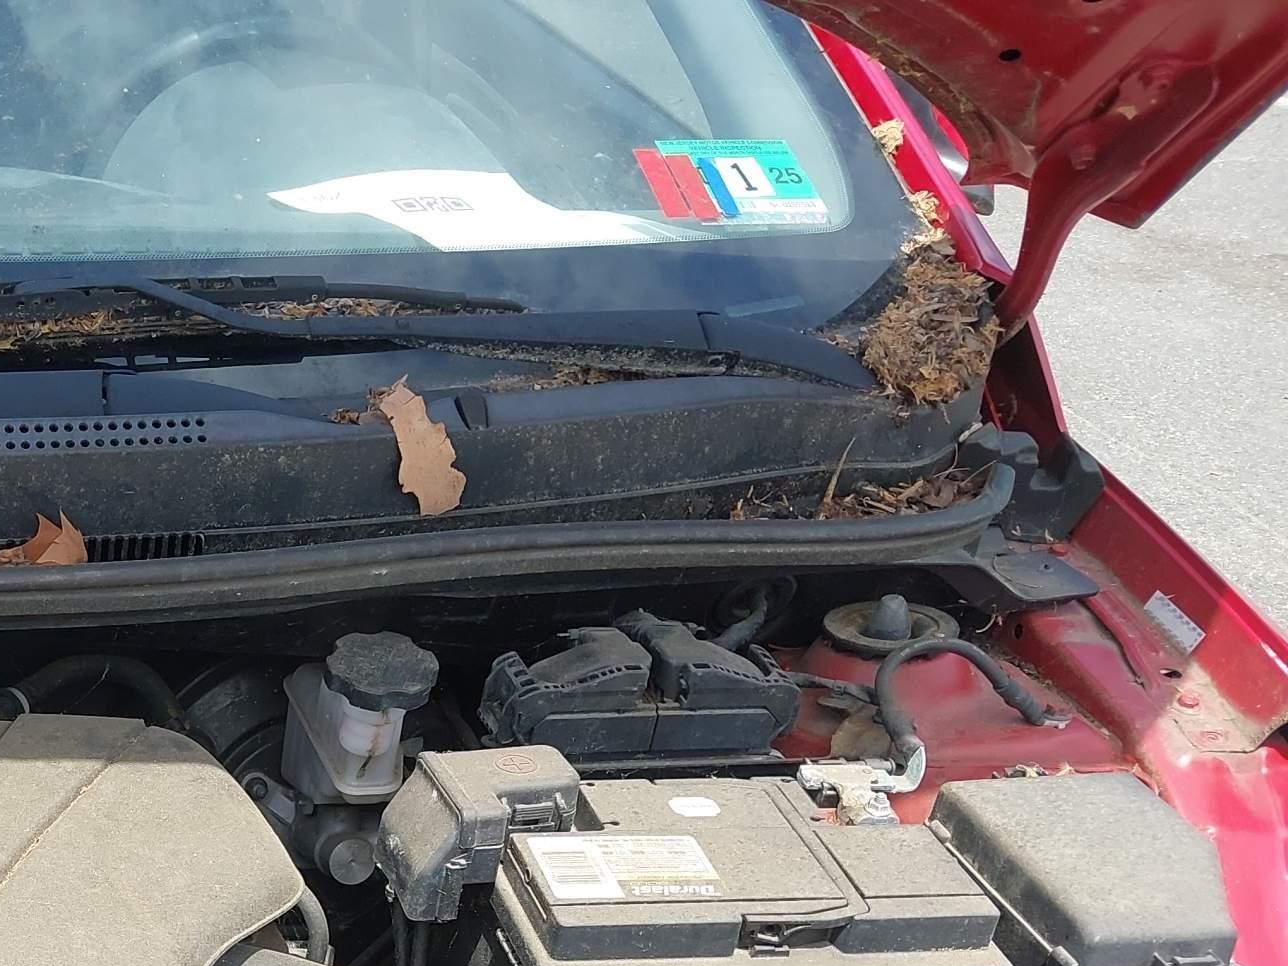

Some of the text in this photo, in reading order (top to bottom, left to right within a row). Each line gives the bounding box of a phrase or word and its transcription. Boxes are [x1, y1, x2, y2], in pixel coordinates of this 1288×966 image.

[730, 162, 759, 191] 1
[768, 166, 803, 185] 25
[632, 885, 715, 897] Duralast
